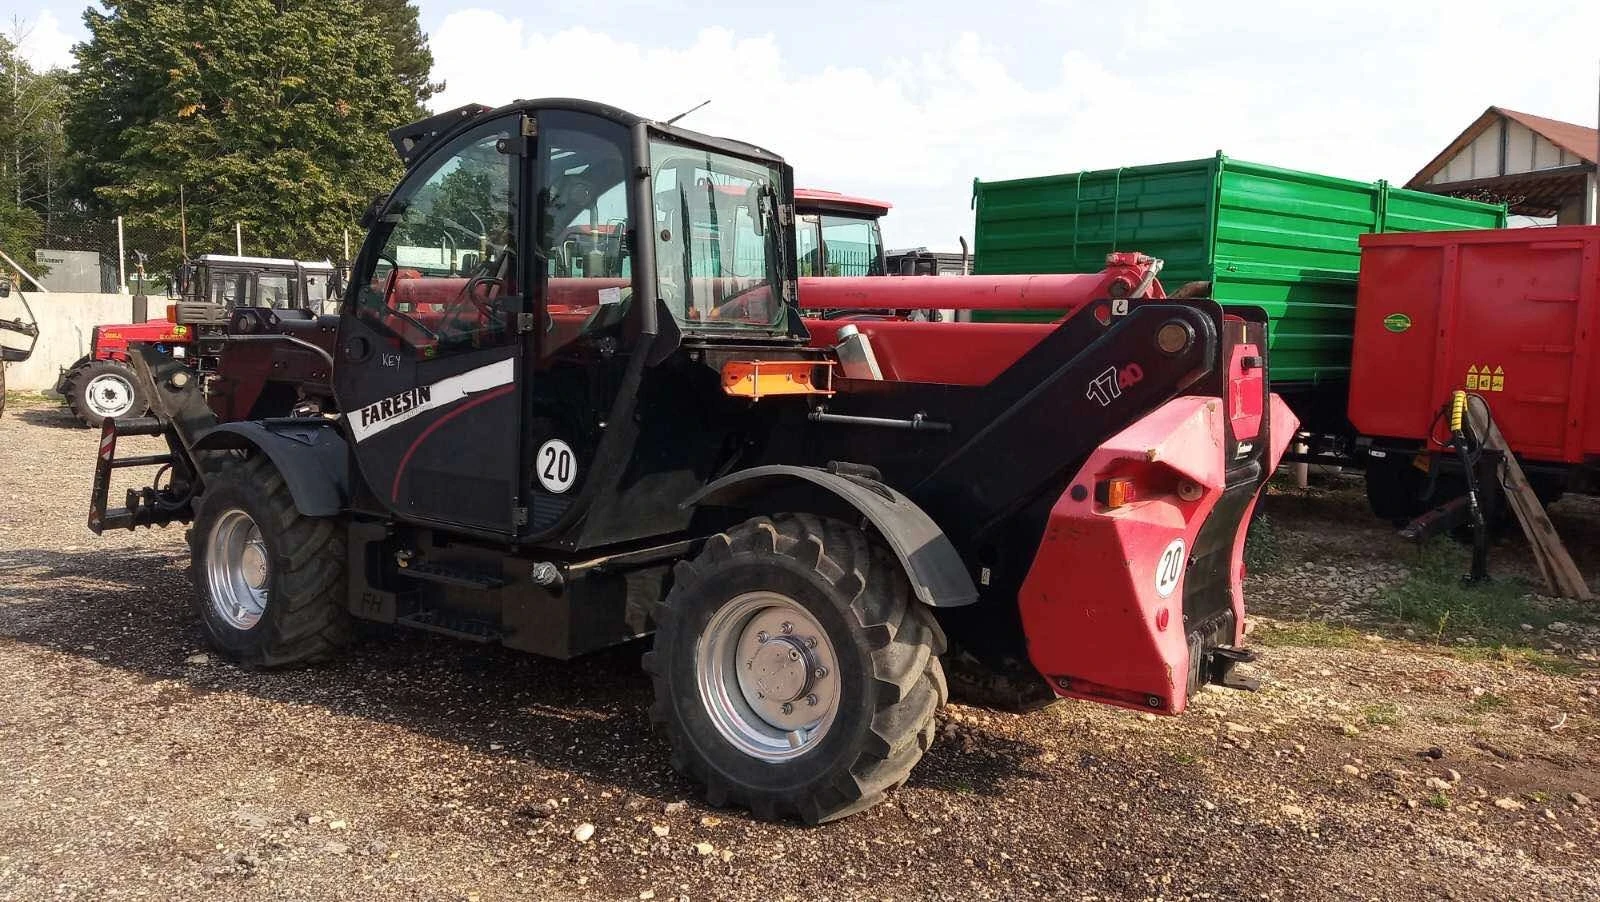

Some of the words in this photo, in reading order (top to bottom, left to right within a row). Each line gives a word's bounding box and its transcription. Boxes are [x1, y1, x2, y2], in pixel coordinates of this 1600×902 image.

[381, 352, 401, 371] KEY
[1086, 362, 1144, 407] 1740
[361, 385, 432, 427] FARESIN
[543, 446, 571, 483] 20
[1160, 546, 1182, 586] 20
